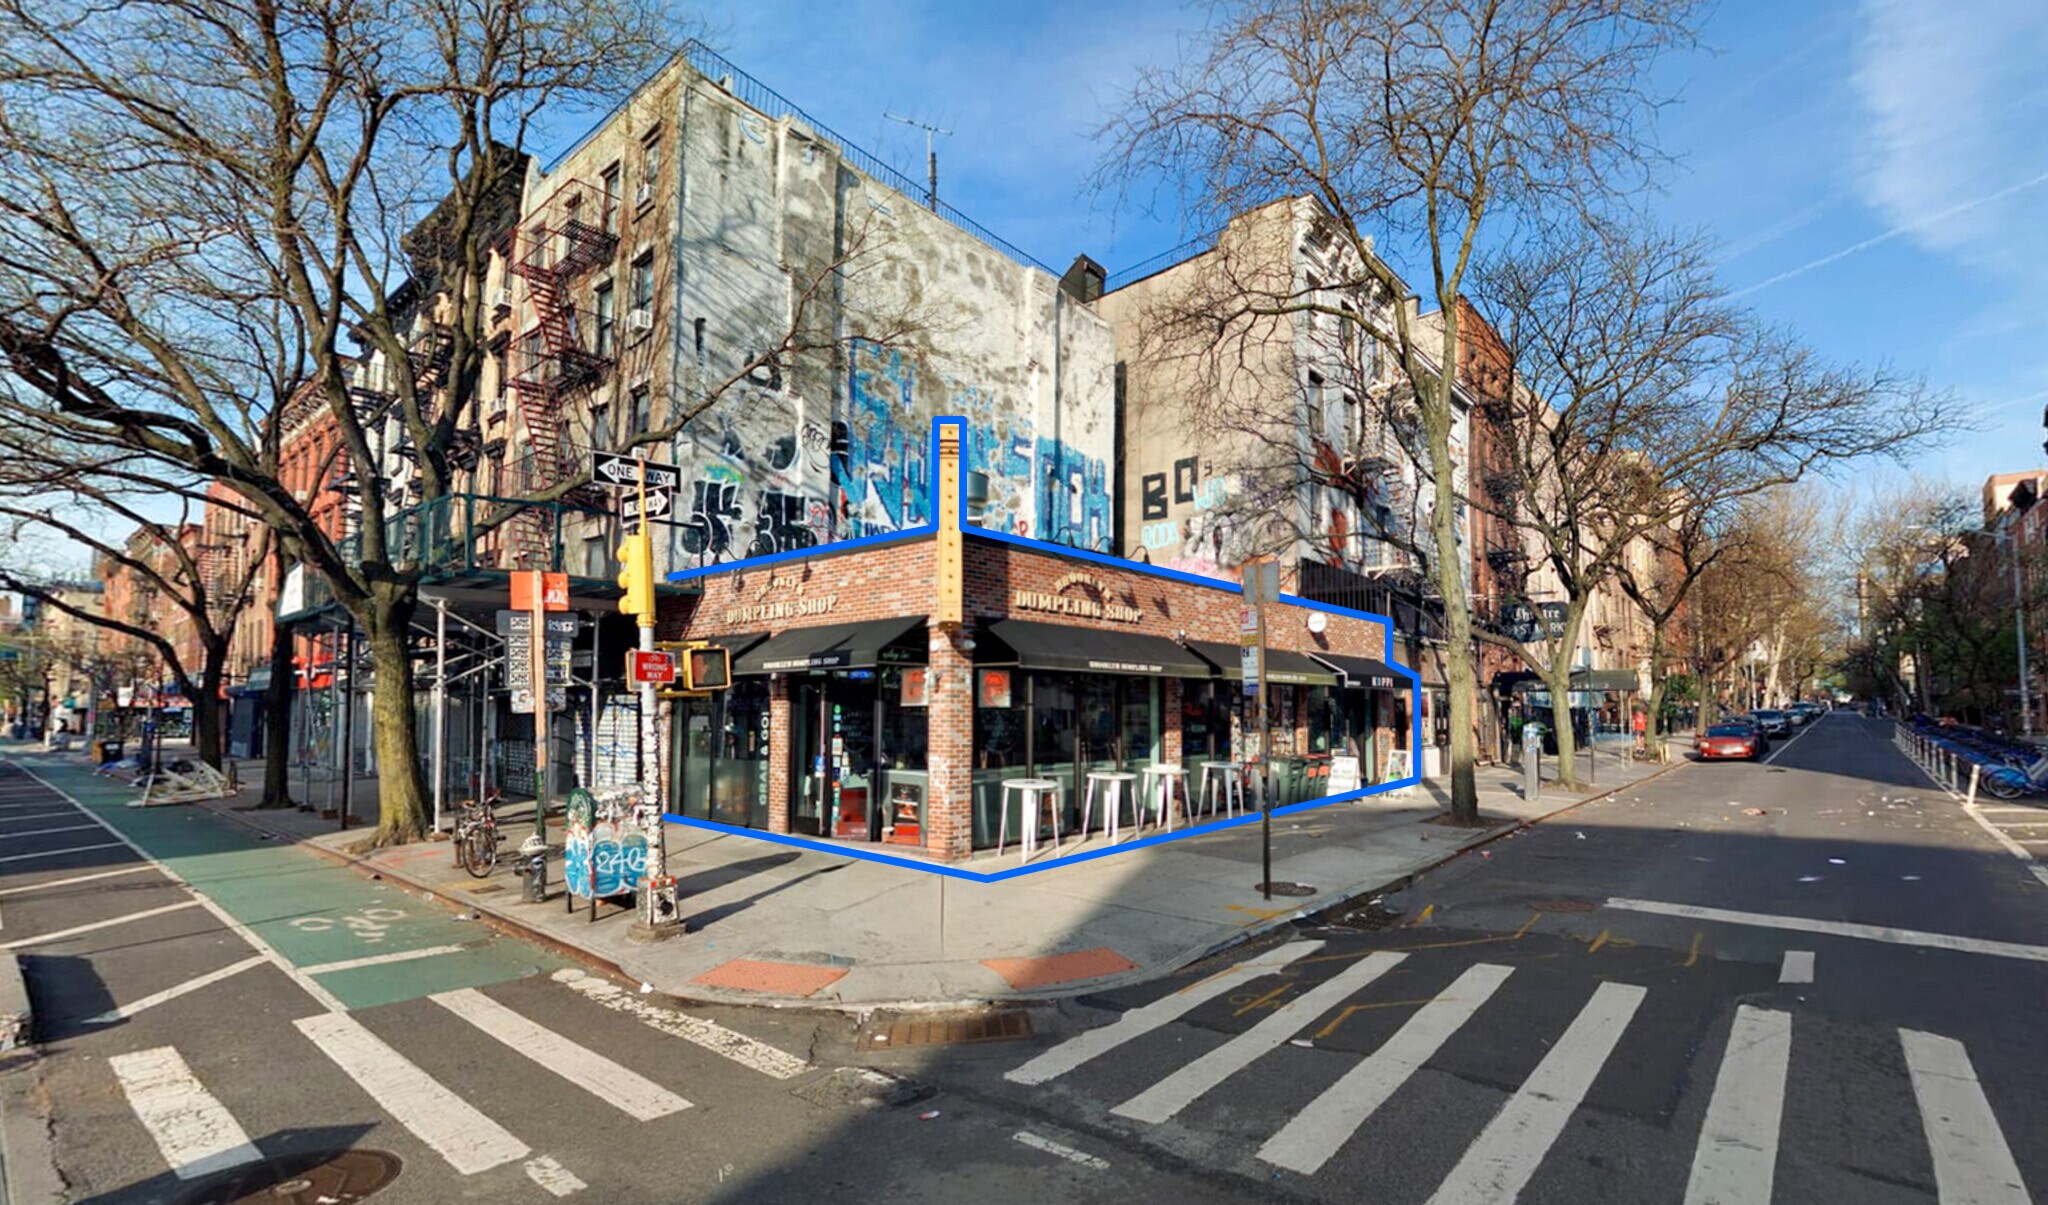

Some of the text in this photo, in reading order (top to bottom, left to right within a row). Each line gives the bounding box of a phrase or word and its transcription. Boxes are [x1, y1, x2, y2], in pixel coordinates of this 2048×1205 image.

[607, 463, 671, 485] ONE WAY
[726, 595, 838, 623] DUMPLING SHOP
[1016, 590, 1142, 622] DUMPLING SHOP
[642, 662, 668, 671] WRONG
